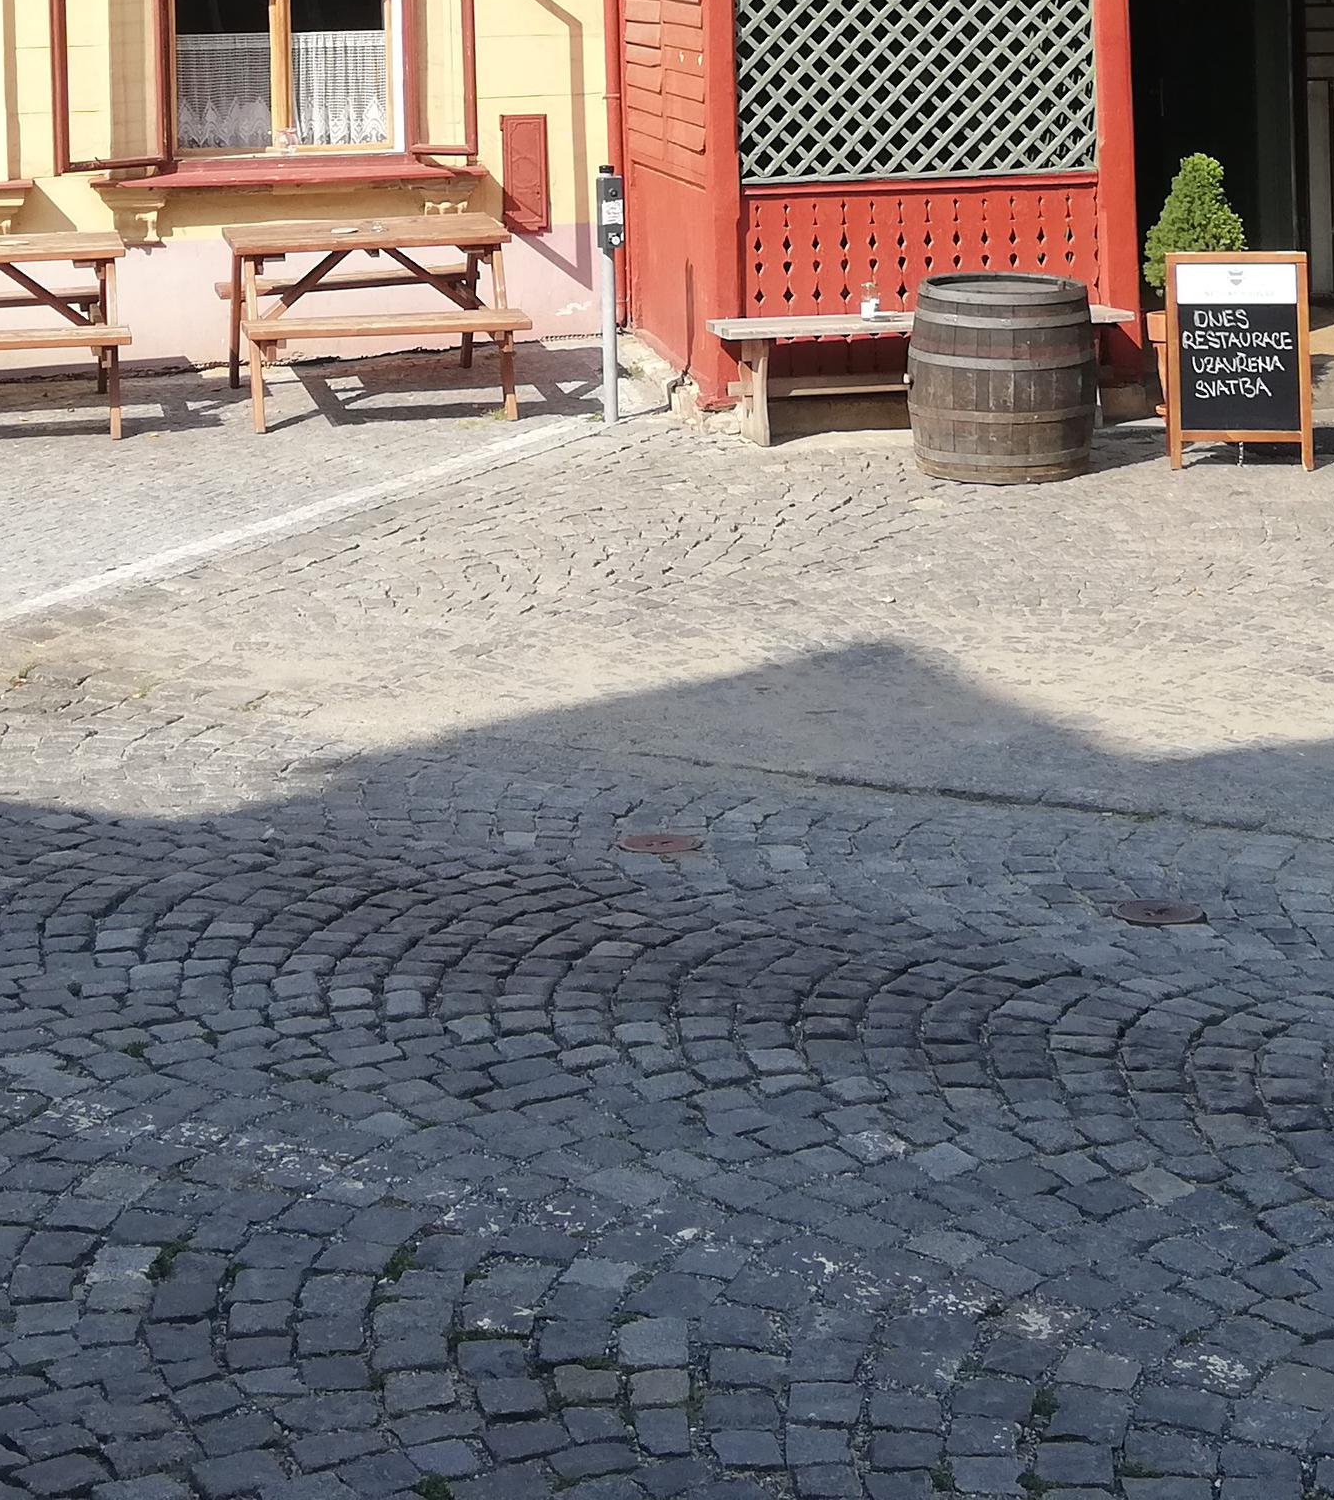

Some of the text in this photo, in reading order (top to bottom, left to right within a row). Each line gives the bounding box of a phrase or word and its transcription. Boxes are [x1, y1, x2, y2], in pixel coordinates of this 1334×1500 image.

[1193, 308, 1250, 329] DNES
[1181, 330, 1293, 350] RESTAURACE
[1191, 352, 1286, 374] UZAVŘENA
[1194, 376, 1273, 399] SVATBA
